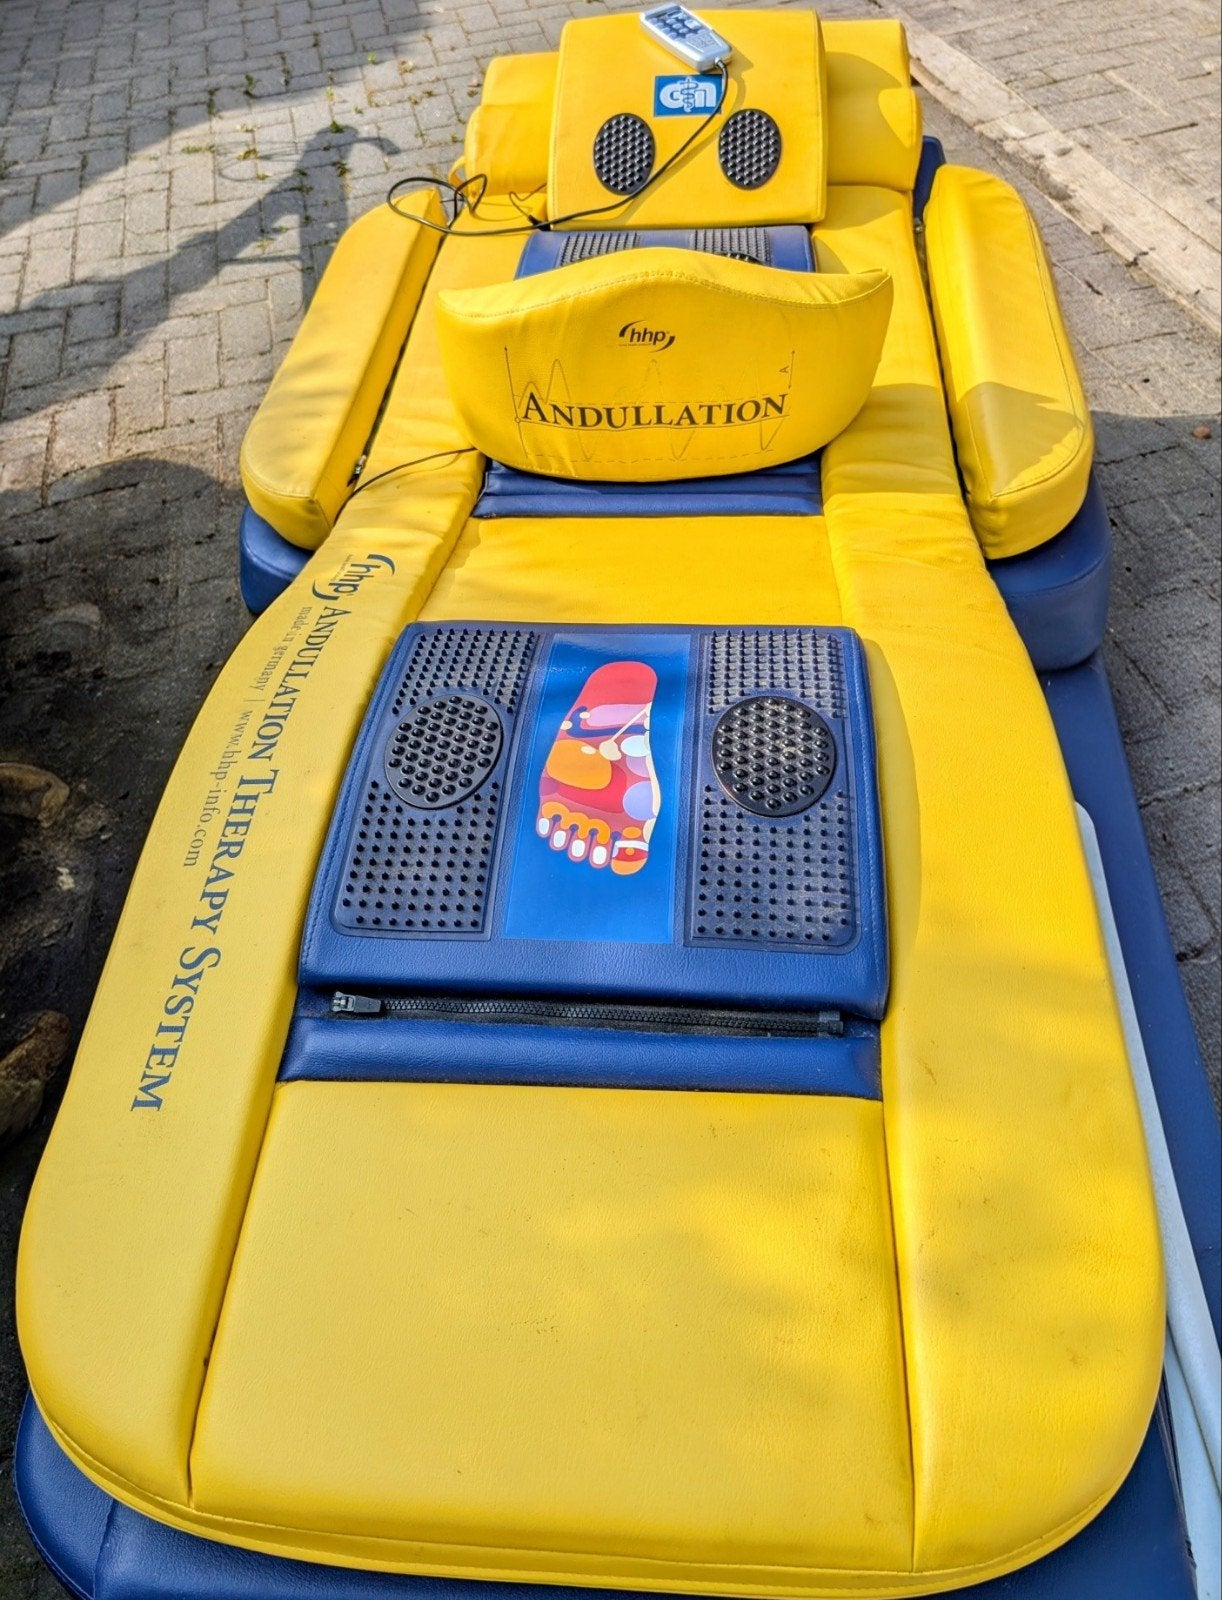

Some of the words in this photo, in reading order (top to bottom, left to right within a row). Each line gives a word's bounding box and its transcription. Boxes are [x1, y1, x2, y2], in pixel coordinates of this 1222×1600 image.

[629, 327, 666, 346] hhp
[521, 391, 790, 430] ANDULLATION
[328, 563, 382, 594] hhp
[282, 631, 302, 642] in
[291, 606, 313, 631] made
[247, 606, 352, 762] ANDULLATION
[249, 645, 288, 691] germany
[183, 710, 253, 867] www.hhp-info.com
[190, 769, 280, 935] THERAPY
[130, 946, 222, 1112] SYSTEM
